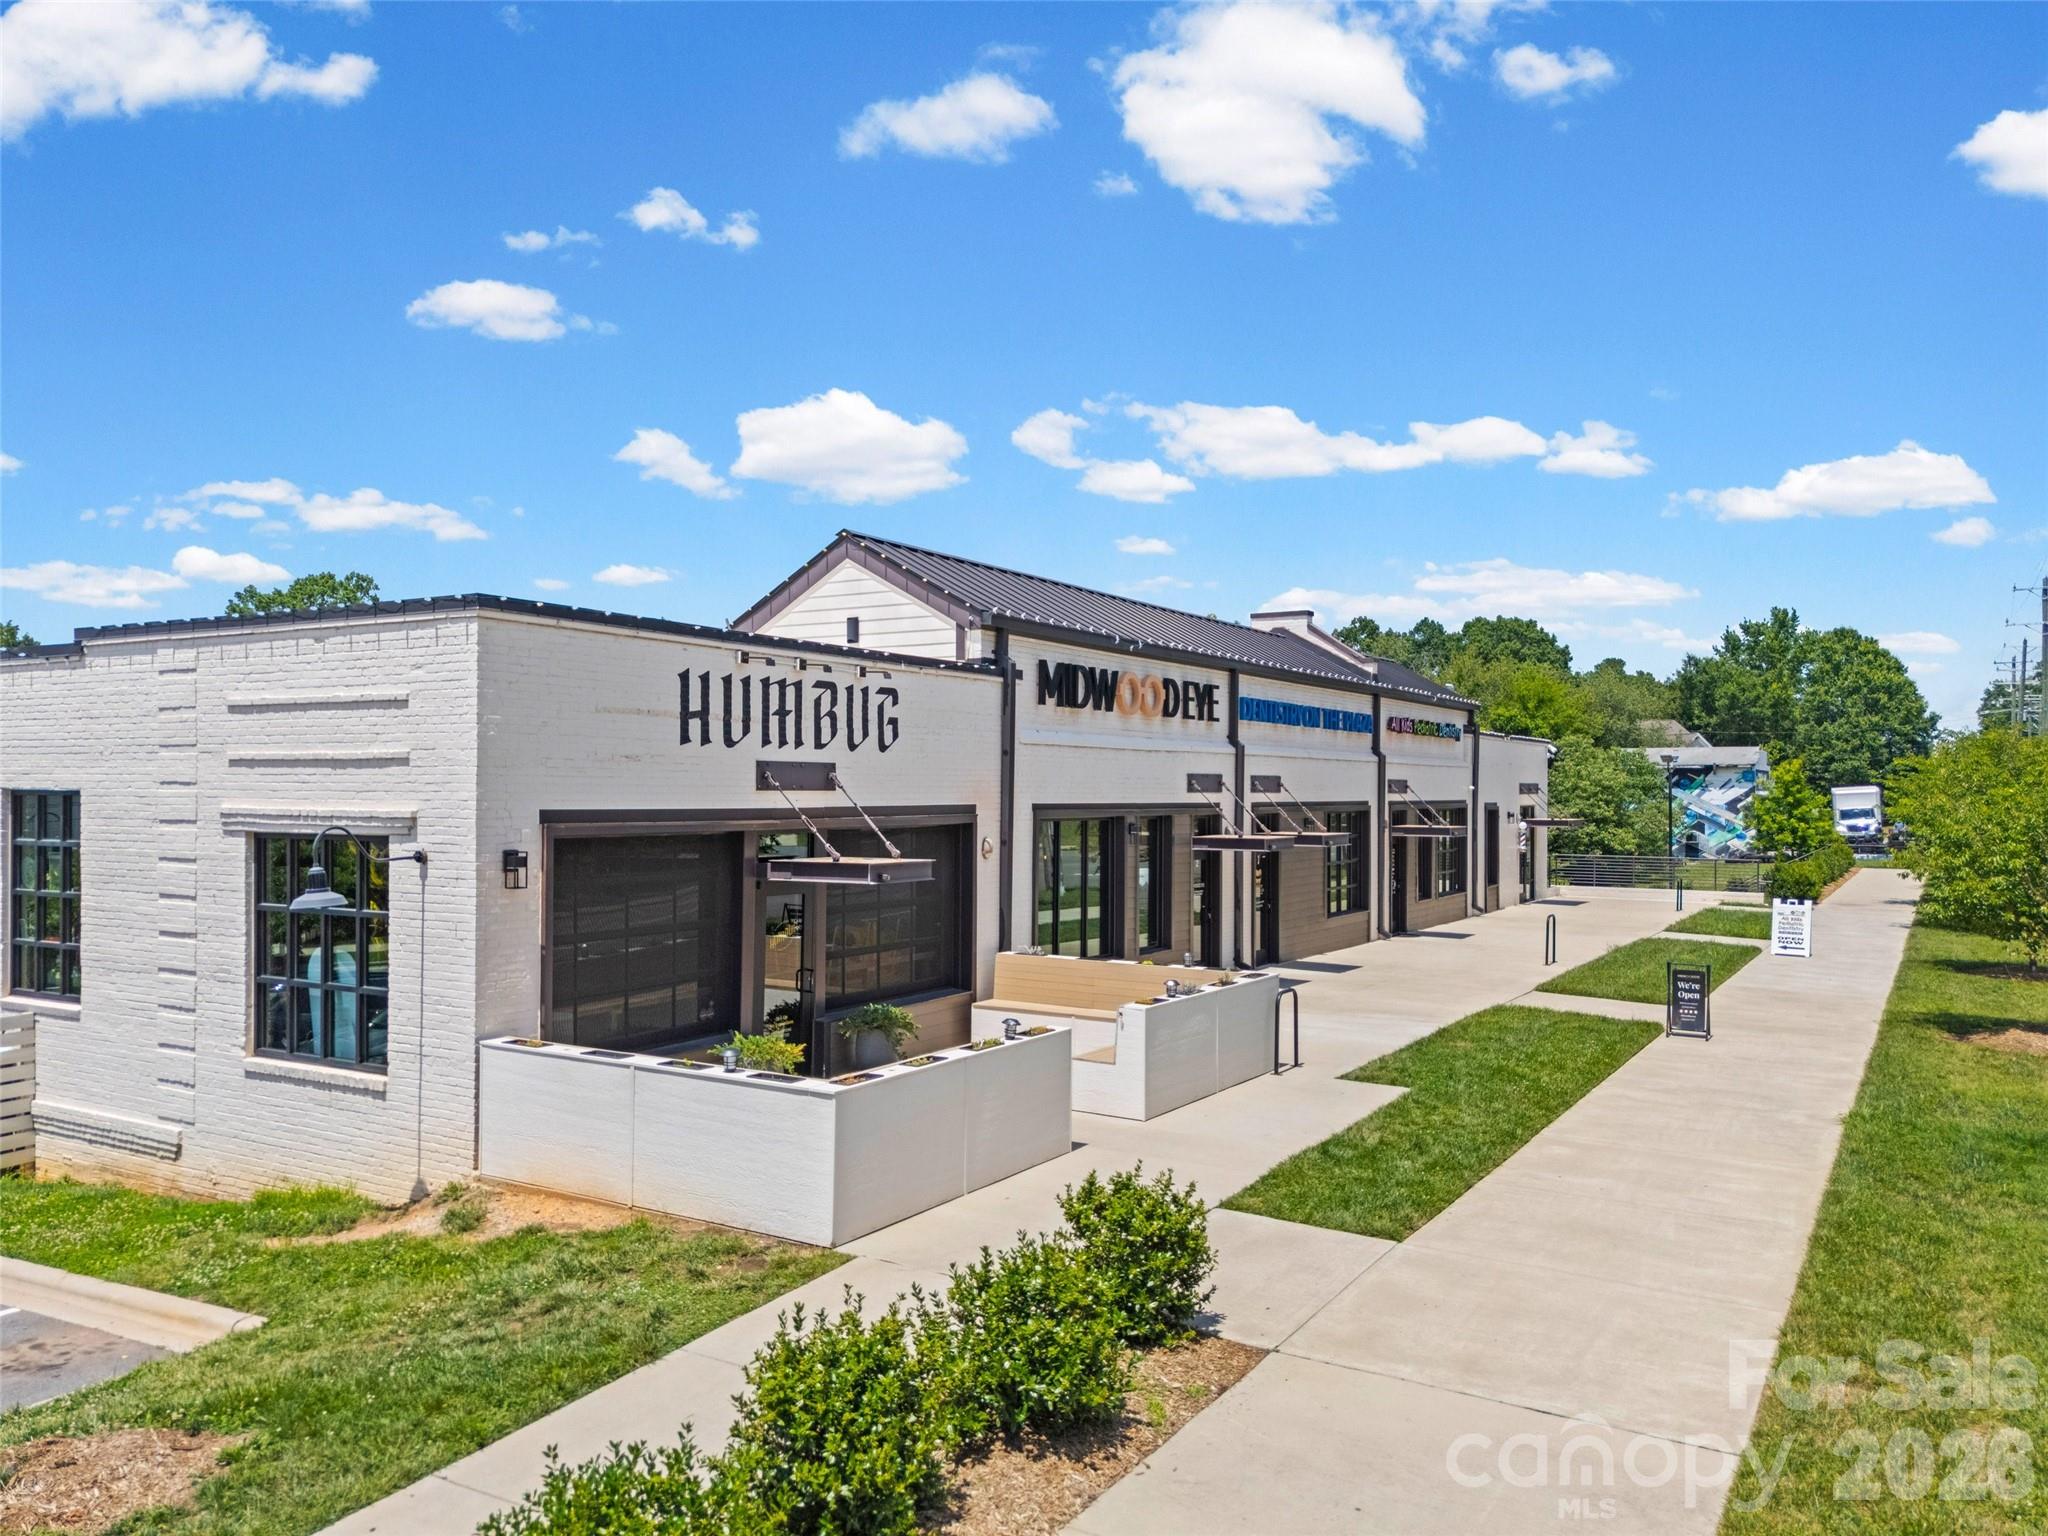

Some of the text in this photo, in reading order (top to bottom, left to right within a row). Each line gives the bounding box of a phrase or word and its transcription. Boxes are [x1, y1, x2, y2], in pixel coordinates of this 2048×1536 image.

[1038, 659, 1220, 722] MIDWOOD EYE
[677, 667, 899, 753] HUMBUG
[1239, 696, 1373, 734] DENTISTRY ON THE PLAZA
[1677, 981, 1700, 990] We're
[1677, 990, 1700, 1000] Open
